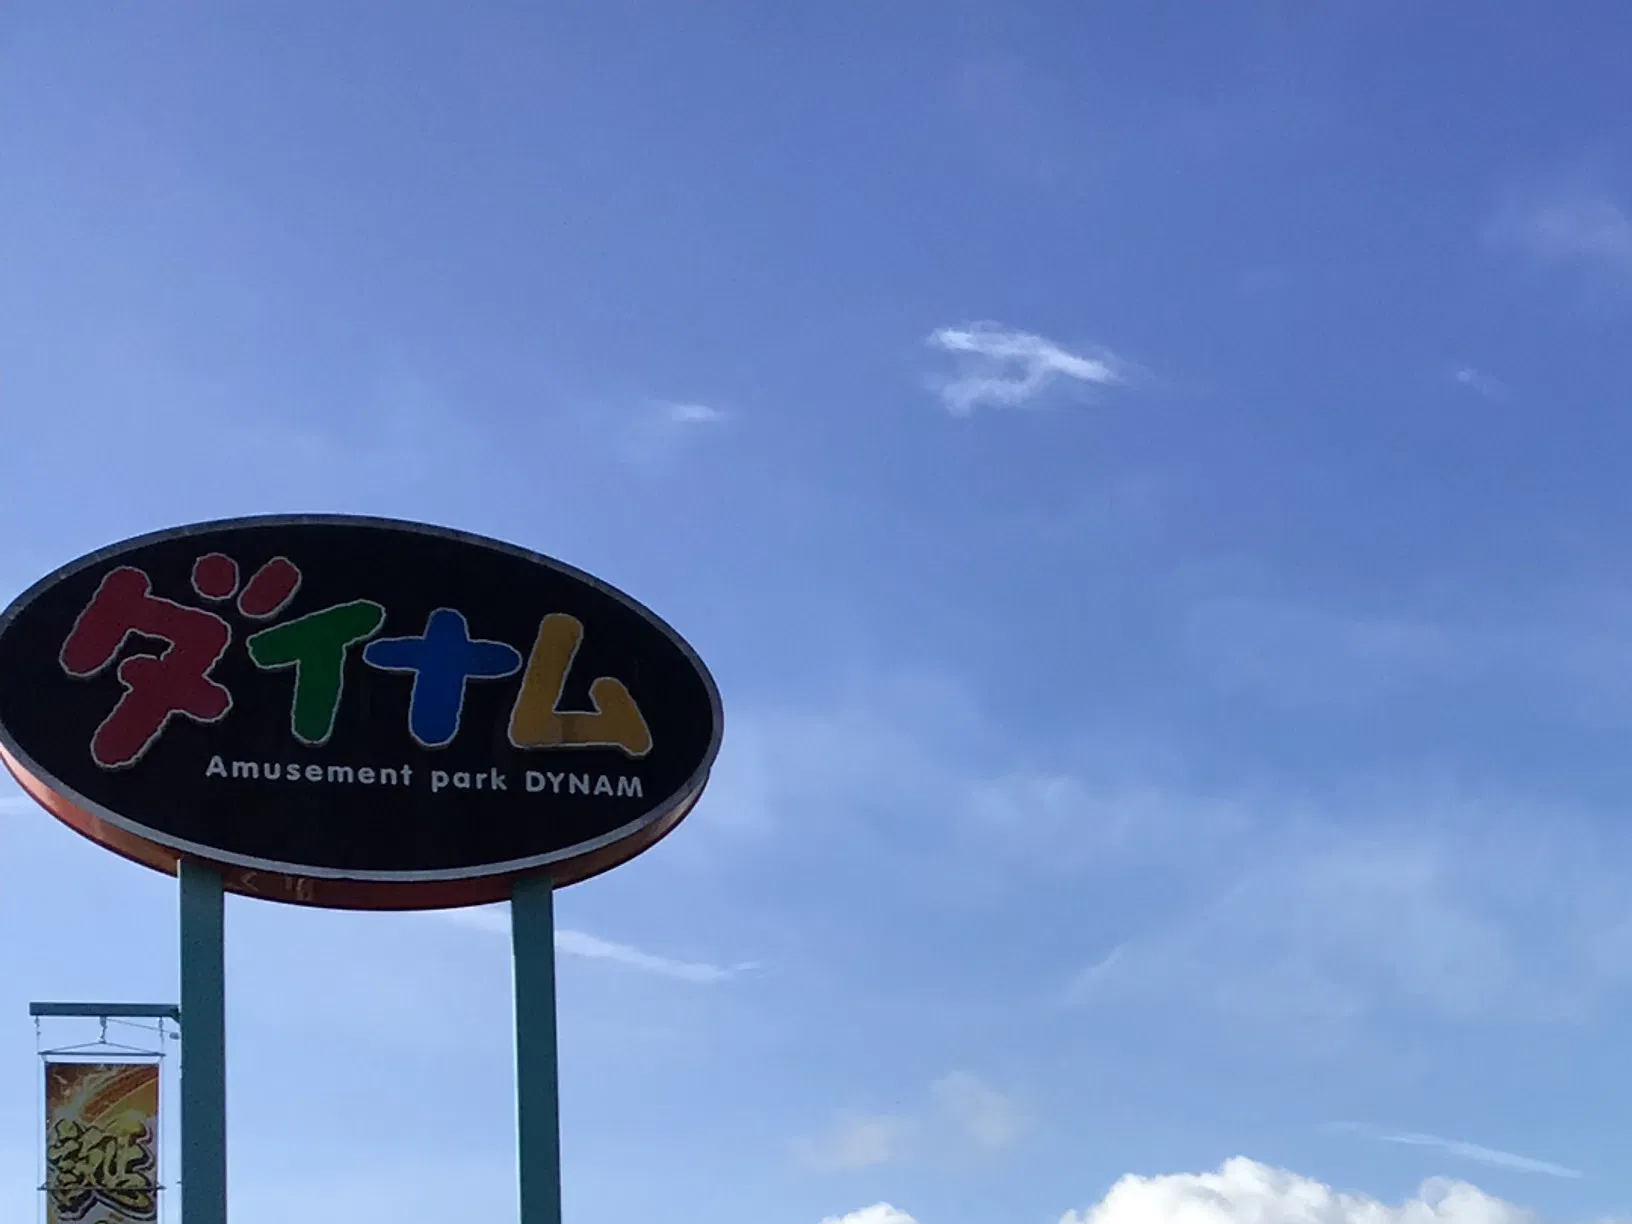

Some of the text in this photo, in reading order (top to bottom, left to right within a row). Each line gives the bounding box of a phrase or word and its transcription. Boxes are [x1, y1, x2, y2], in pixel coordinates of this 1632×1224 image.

[60, 553, 653, 768] ダイナム
[206, 755, 643, 798] Amusement park DYNAM
